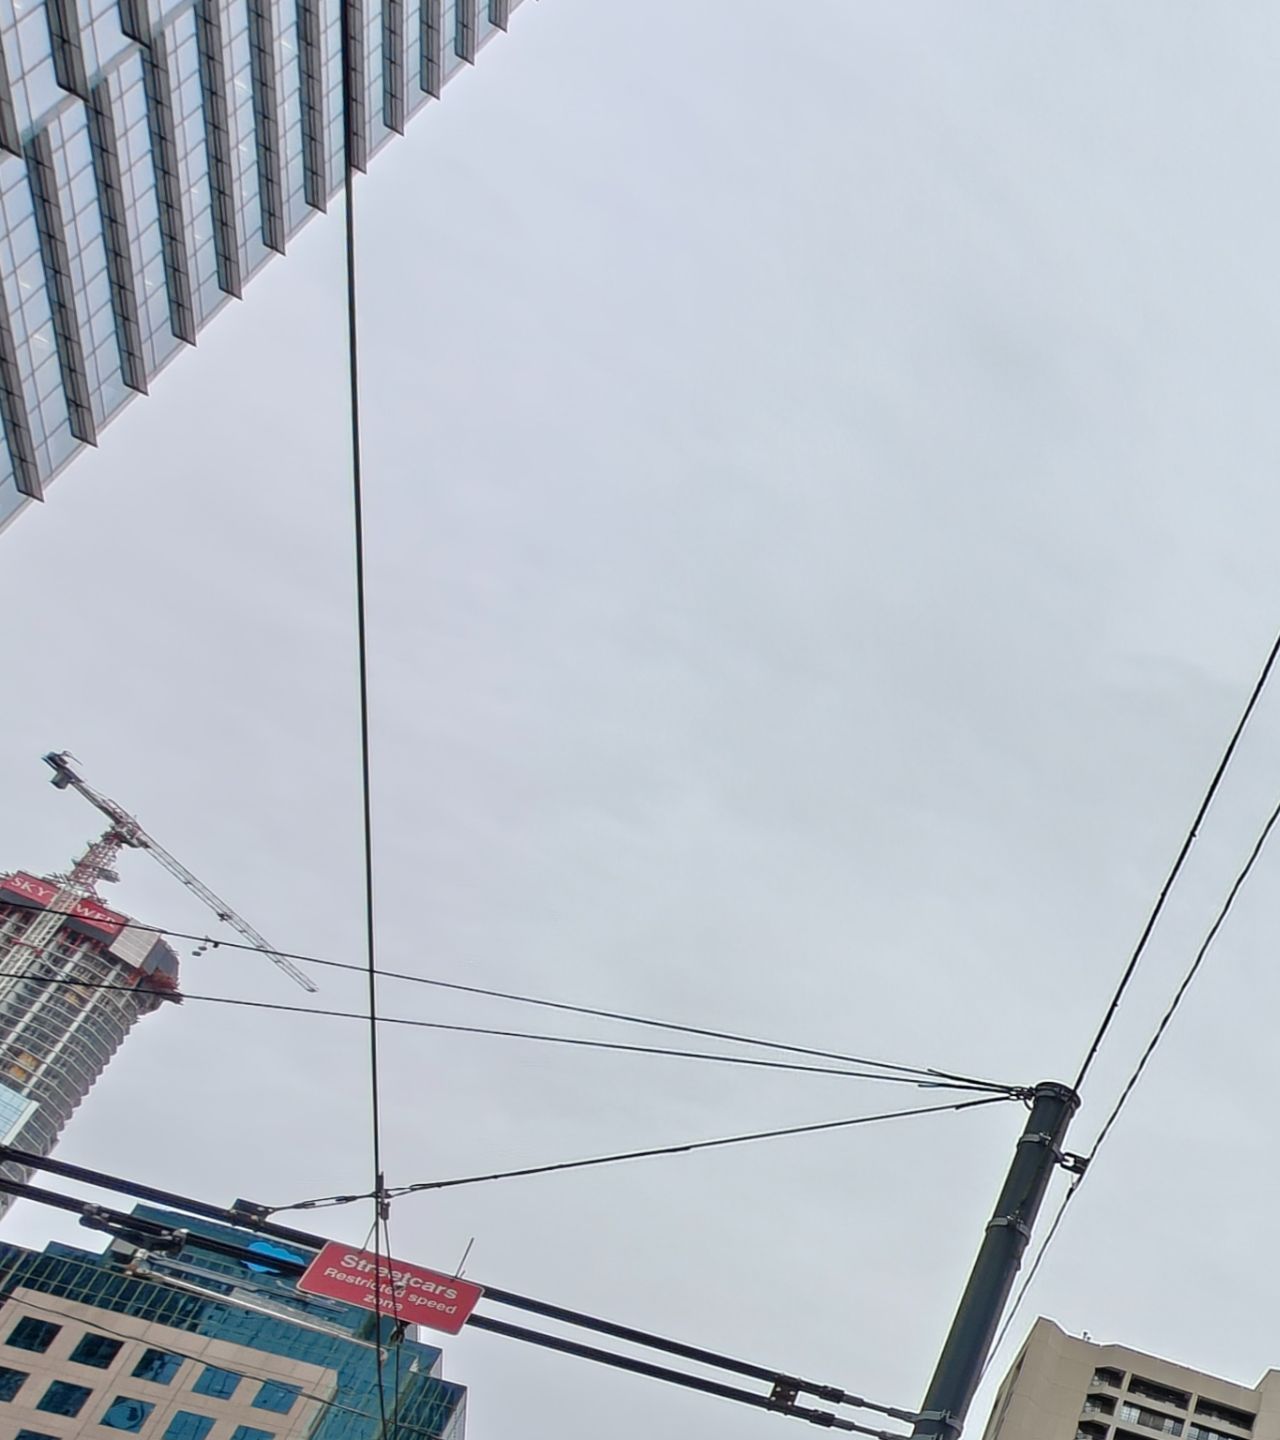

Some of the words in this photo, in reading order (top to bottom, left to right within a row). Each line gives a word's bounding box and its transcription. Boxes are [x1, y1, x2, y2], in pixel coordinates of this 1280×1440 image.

[11, 877, 50, 898] SKY
[323, 1267, 406, 1298] Restricted
[407, 1293, 458, 1315] speed
[340, 1254, 458, 1300] Streetcars
[363, 1293, 404, 1312] zone
